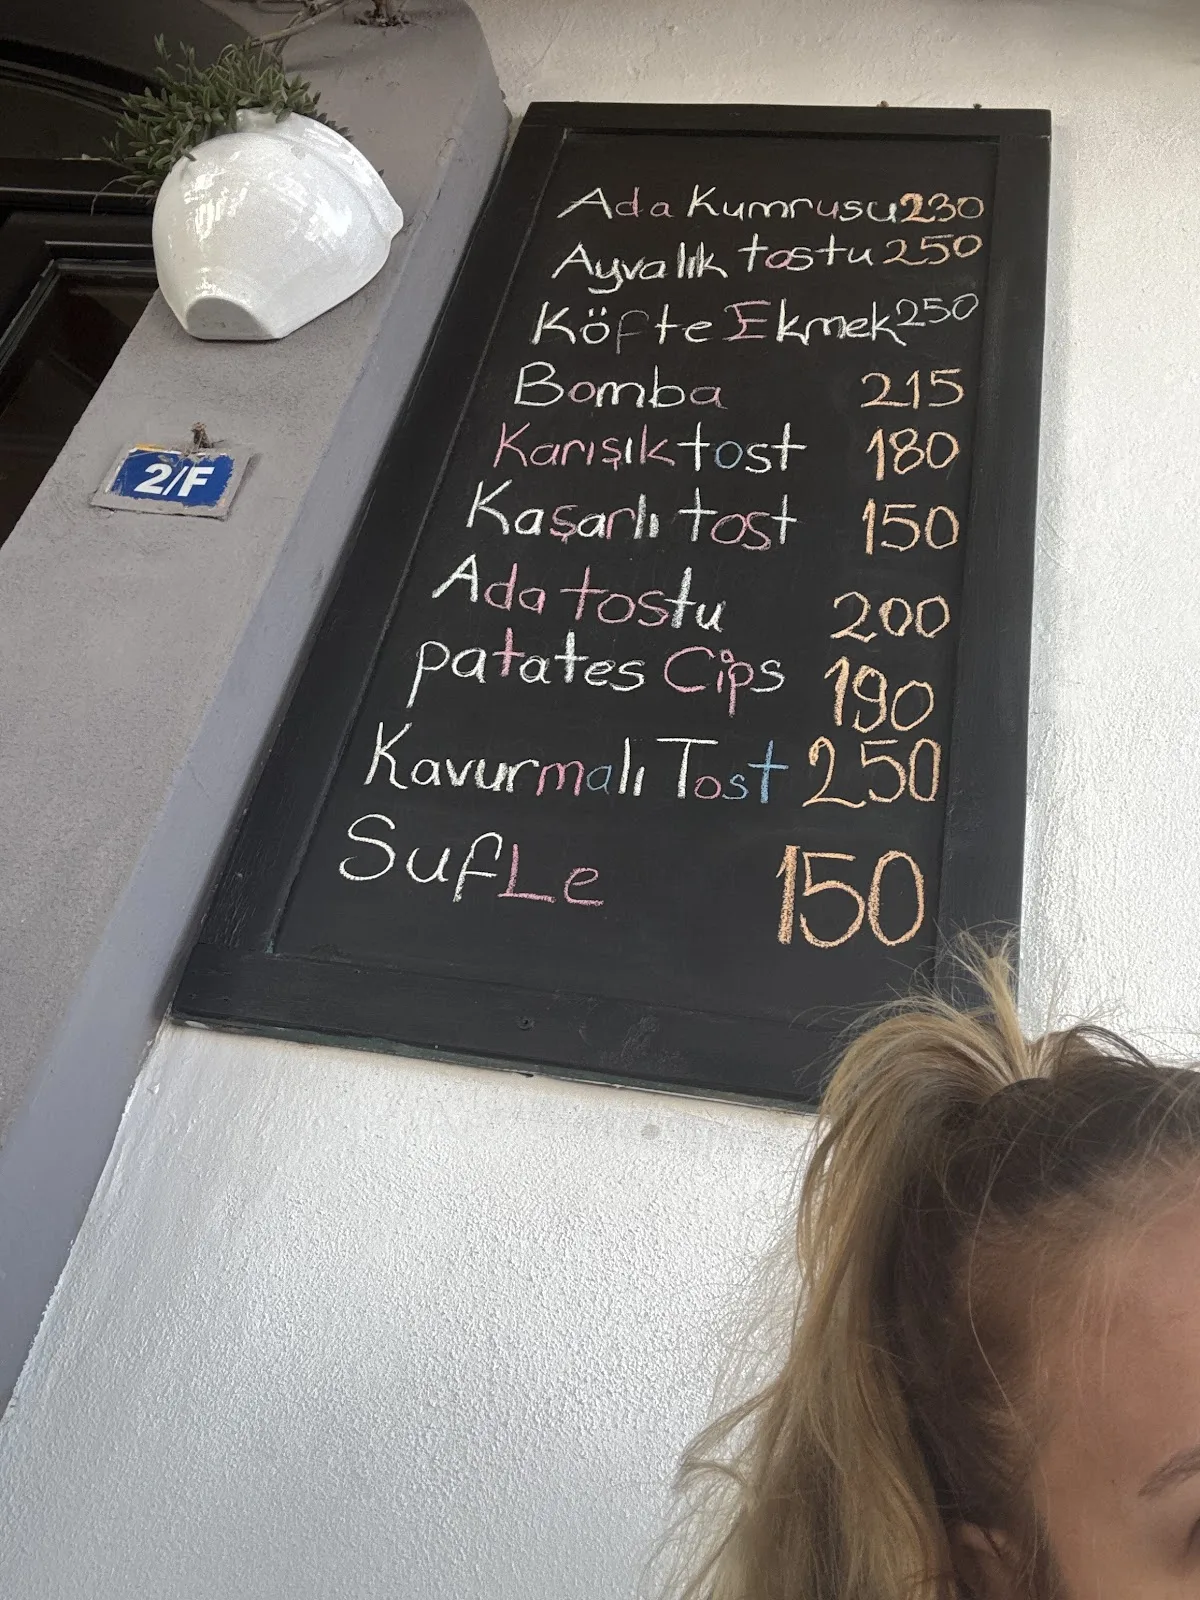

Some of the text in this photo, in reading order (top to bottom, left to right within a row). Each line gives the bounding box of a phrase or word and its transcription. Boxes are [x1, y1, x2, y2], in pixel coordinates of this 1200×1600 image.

[557, 186, 674, 219] Ada
[900, 192, 984, 223] 230
[738, 232, 874, 272] tostu
[884, 233, 984, 266] 250
[531, 293, 980, 354] Köfte Ekmek 250
[513, 361, 965, 410] Bomba 215
[134, 463, 215, 497] 2/F
[493, 421, 961, 482] Karışık tost 180
[466, 478, 961, 555] Kaşarlı tost 150
[431, 553, 951, 643] Ada tostu 200
[824, 656, 936, 733] 190
[363, 721, 942, 810] Kavurmalı Tost 250
[776, 844, 926, 949] 150
